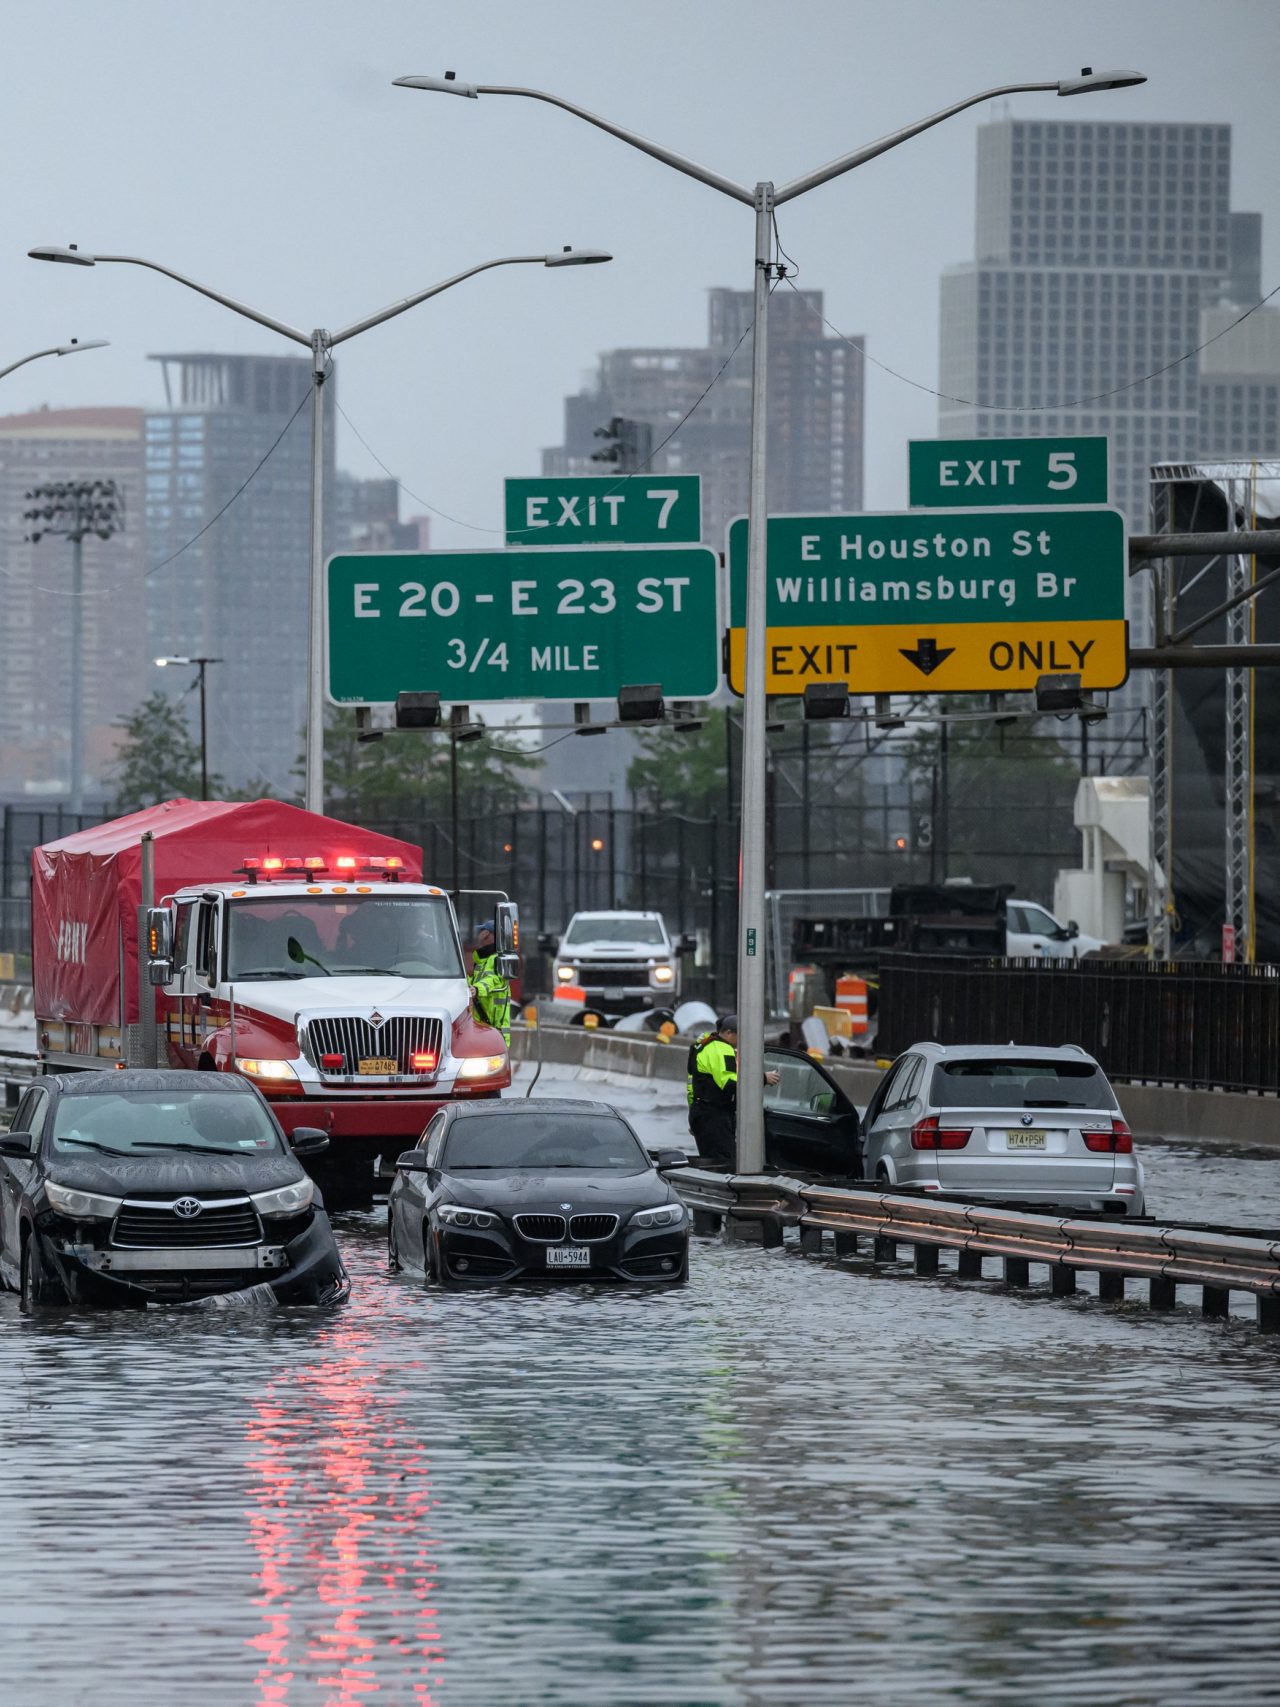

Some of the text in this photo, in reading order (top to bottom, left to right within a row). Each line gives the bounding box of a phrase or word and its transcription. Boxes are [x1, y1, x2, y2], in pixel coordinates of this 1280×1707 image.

[939, 452, 1078, 491] EXIT 5
[526, 489, 680, 529] EXIT 7
[801, 530, 1051, 561] E Houston St
[353, 583, 381, 618] E
[398, 581, 461, 617] 20
[511, 580, 539, 616] E
[556, 578, 617, 614] 23
[635, 577, 691, 613] ST
[775, 572, 1077, 607] Williamsburg Br
[446, 638, 600, 673] 3/4 MILE
[771, 639, 1096, 676] EXIT ONLY
[57, 919, 88, 965] FDNY
